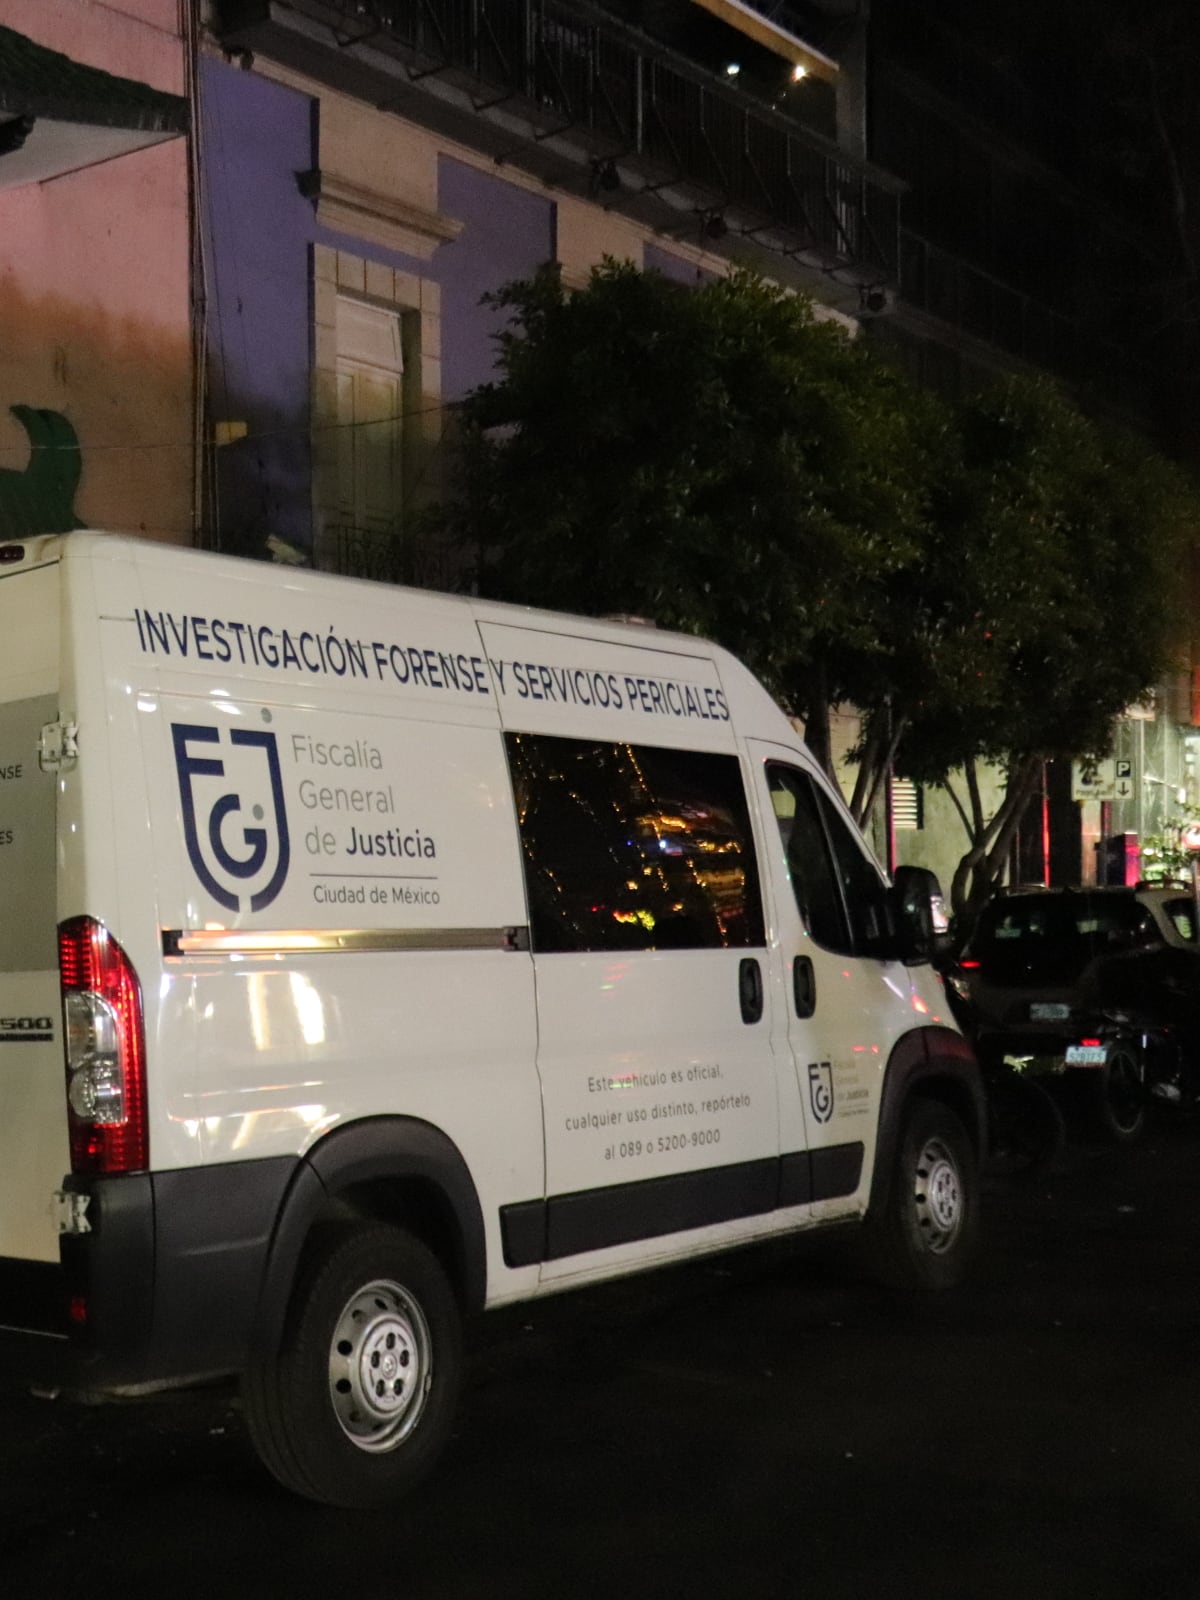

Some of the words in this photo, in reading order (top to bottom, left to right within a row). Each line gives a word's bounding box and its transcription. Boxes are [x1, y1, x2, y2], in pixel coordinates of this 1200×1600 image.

[134, 608, 369, 679] INVESTIGACIÓN
[371, 642, 490, 694] FORENSE
[489, 658, 507, 696] Y
[511, 660, 624, 710] SERVICIOS
[623, 677, 730, 721] PERICIALES
[291, 733, 383, 770] Fiscalía
[1117, 761, 1130, 777] P
[298, 779, 395, 814] General
[305, 826, 337, 856] de
[345, 826, 437, 859] Justicia
[313, 884, 366, 904] Ciudad
[369, 885, 388, 904] de
[391, 886, 441, 905] México
[587, 1076, 615, 1093] Este
[671, 1069, 684, 1083] es
[565, 1111, 623, 1131] cualquier
[626, 1111, 648, 1123] uso
[651, 1101, 699, 1120] distinto,
[701, 1094, 752, 1114] repórtelo
[604, 1145, 615, 1160] al
[619, 1140, 643, 1158] 089
[646, 1142, 654, 1154] o
[657, 1128, 722, 1152] 5200-9000
